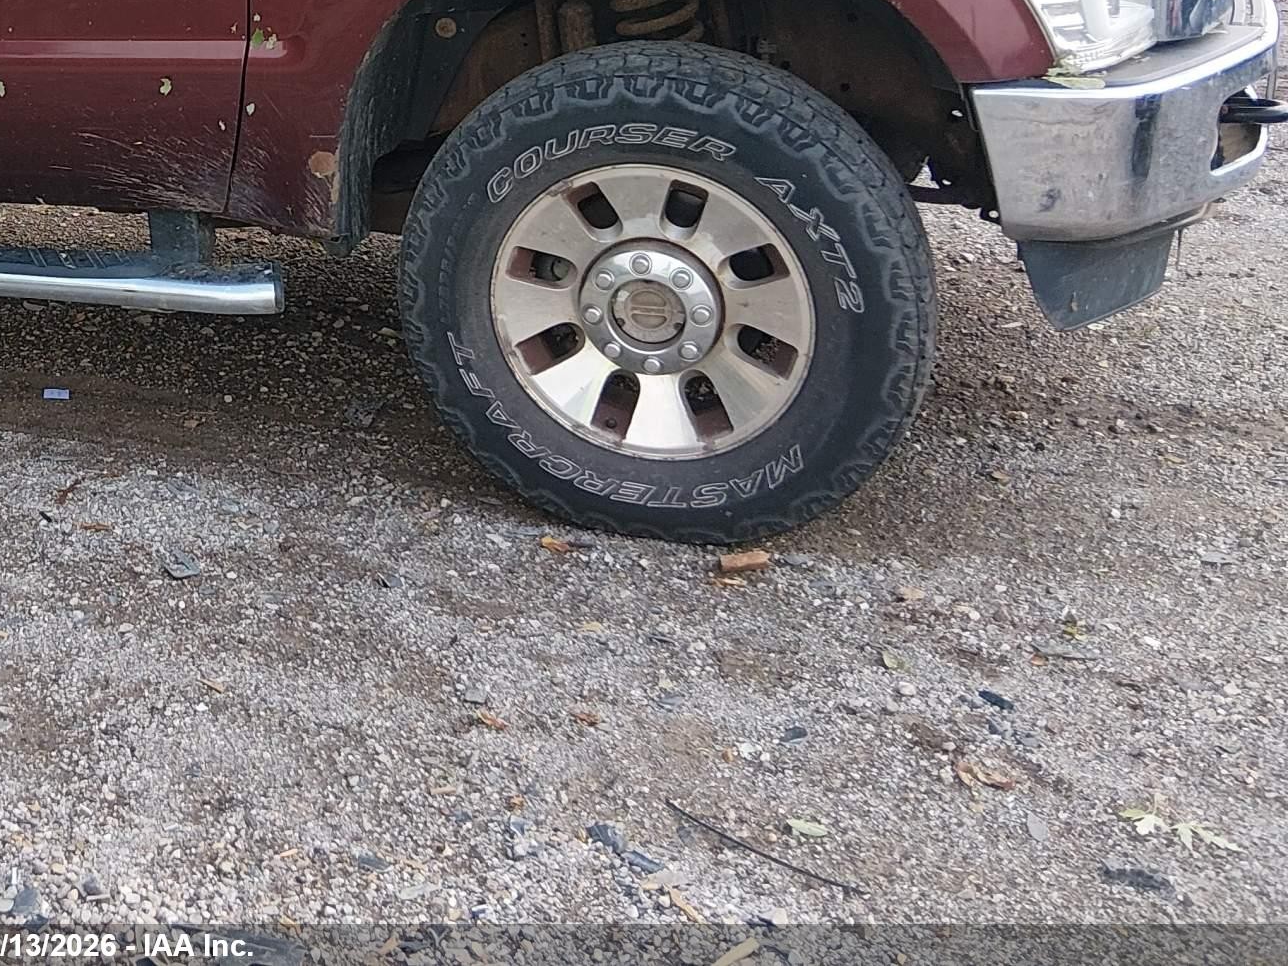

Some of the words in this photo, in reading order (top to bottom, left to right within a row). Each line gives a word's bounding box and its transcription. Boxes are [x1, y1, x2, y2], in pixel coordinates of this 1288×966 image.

[486, 123, 737, 203] COURSER
[754, 175, 865, 314] AXT2
[446, 331, 805, 509] MASTERCRAFT
